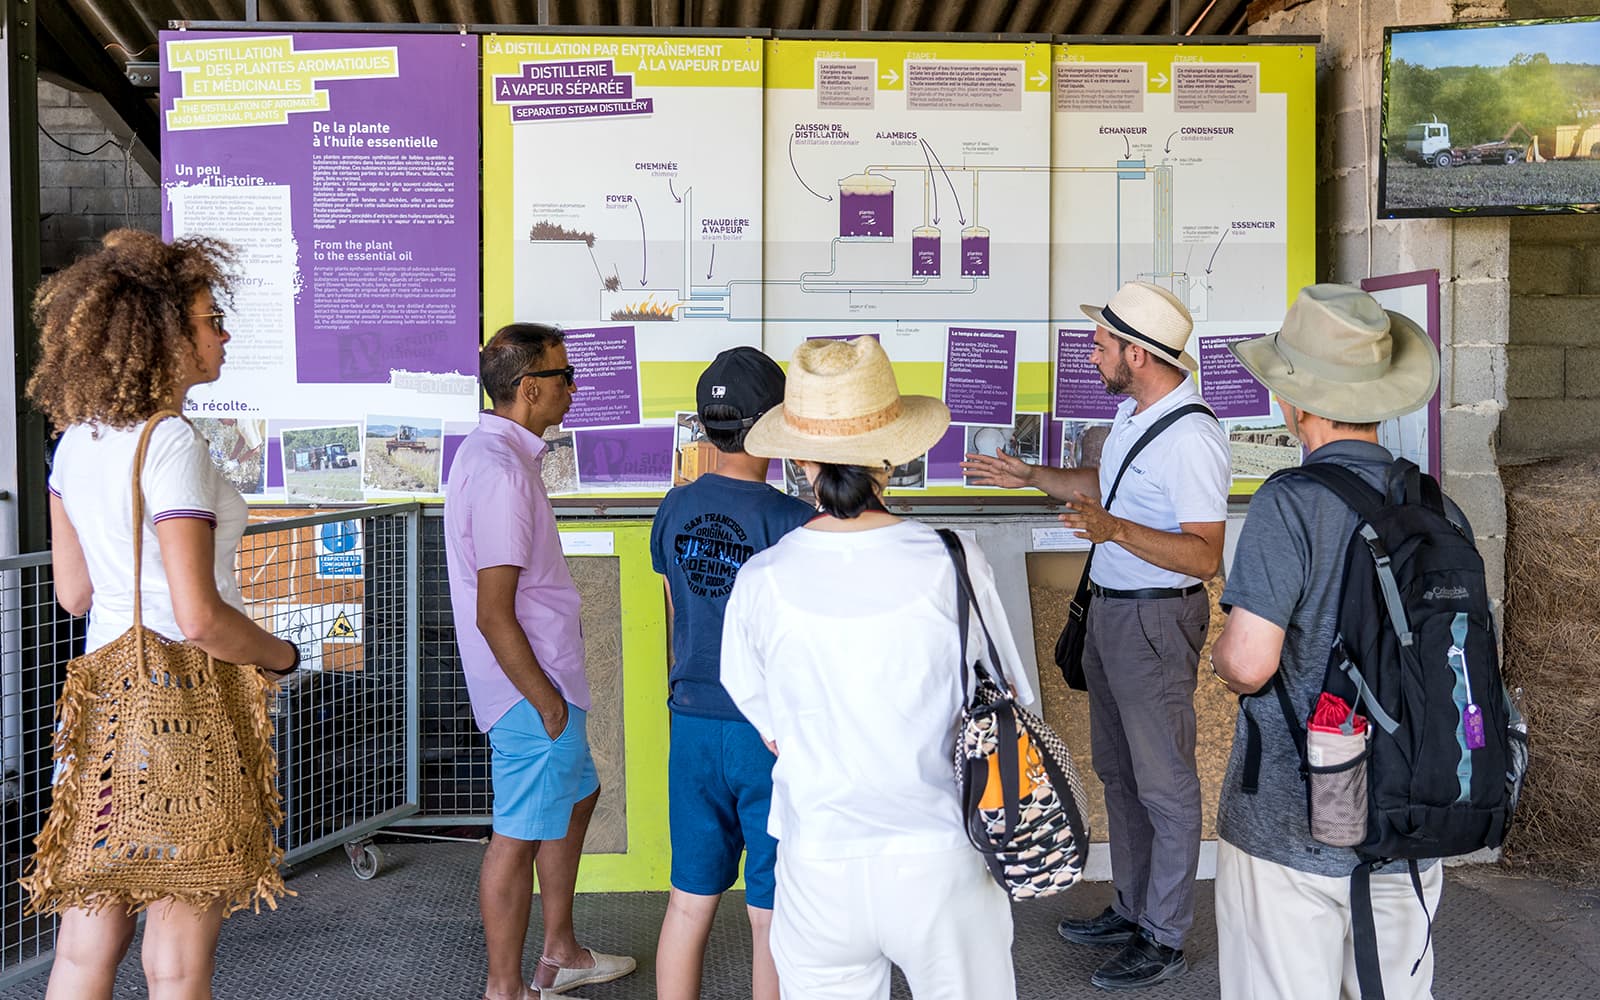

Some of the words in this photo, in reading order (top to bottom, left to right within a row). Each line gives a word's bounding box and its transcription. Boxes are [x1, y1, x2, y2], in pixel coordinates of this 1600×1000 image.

[176, 48, 192, 63] LA
[195, 46, 283, 62] DISTILLATION
[486, 43, 504, 55] LA
[505, 43, 591, 56] DISTILLATION
[594, 43, 619, 56] PAR
[621, 42, 723, 57] ENTRAÎNEMENT
[206, 63, 232, 77] DES
[234, 60, 295, 76] PLANTES
[297, 56, 391, 73] AROMATIQUES
[638, 55, 648, 71] À
[650, 60, 667, 71] LA
[669, 60, 719, 72] VAPEUR
[721, 60, 760, 73] D'EAU
[531, 64, 607, 79] DISTILLERIE
[193, 79, 209, 93] ET
[212, 76, 302, 92] MÉDICINALES
[501, 80, 511, 96] À
[512, 82, 563, 96] VAPEUR
[566, 79, 624, 95] SÉPARÉE
[182, 104, 198, 113] THE
[199, 101, 259, 113] DISTILLATION
[261, 100, 272, 109] OF
[274, 97, 319, 108] AROMATIC
[516, 105, 567, 117] SEPARATED
[568, 104, 598, 115] STEAM
[599, 101, 648, 114] DISTILLERY
[194, 113, 242, 124] MEDICINAL
[243, 110, 280, 121] PLANTS
[313, 121, 331, 134] De
[333, 121, 347, 134] la
[349, 121, 390, 137] plante
[795, 131, 849, 139] DISTILLATION
[876, 131, 918, 139] ALAMBICS
[1099, 126, 1148, 135] ÉCHANGEUR
[1180, 127, 1234, 135] CONDENSEUR
[313, 135, 321, 148] à
[324, 135, 364, 148] l'huile
[367, 135, 439, 149] essentielle
[175, 164, 193, 175] Un
[196, 165, 221, 178] peu
[635, 161, 678, 170] CHEMINÉE
[202, 174, 277, 187] d'histoire...
[606, 195, 633, 203] FOYER
[702, 217, 750, 226] CHAUDIÈRE
[1231, 221, 1276, 229] ESSENCIER
[709, 226, 743, 234] VAPEUR
[314, 240, 343, 250] From
[344, 240, 362, 250] the
[365, 240, 393, 252] plant
[314, 251, 325, 261] to
[327, 251, 345, 261] the
[347, 251, 396, 261] essential
[399, 251, 413, 261] oil
[184, 399, 198, 411] La
[202, 399, 260, 411] récolte...
[684, 515, 703, 532] SAN
[704, 512, 748, 542] FRANCISCO
[695, 527, 734, 542] ORIGINAL
